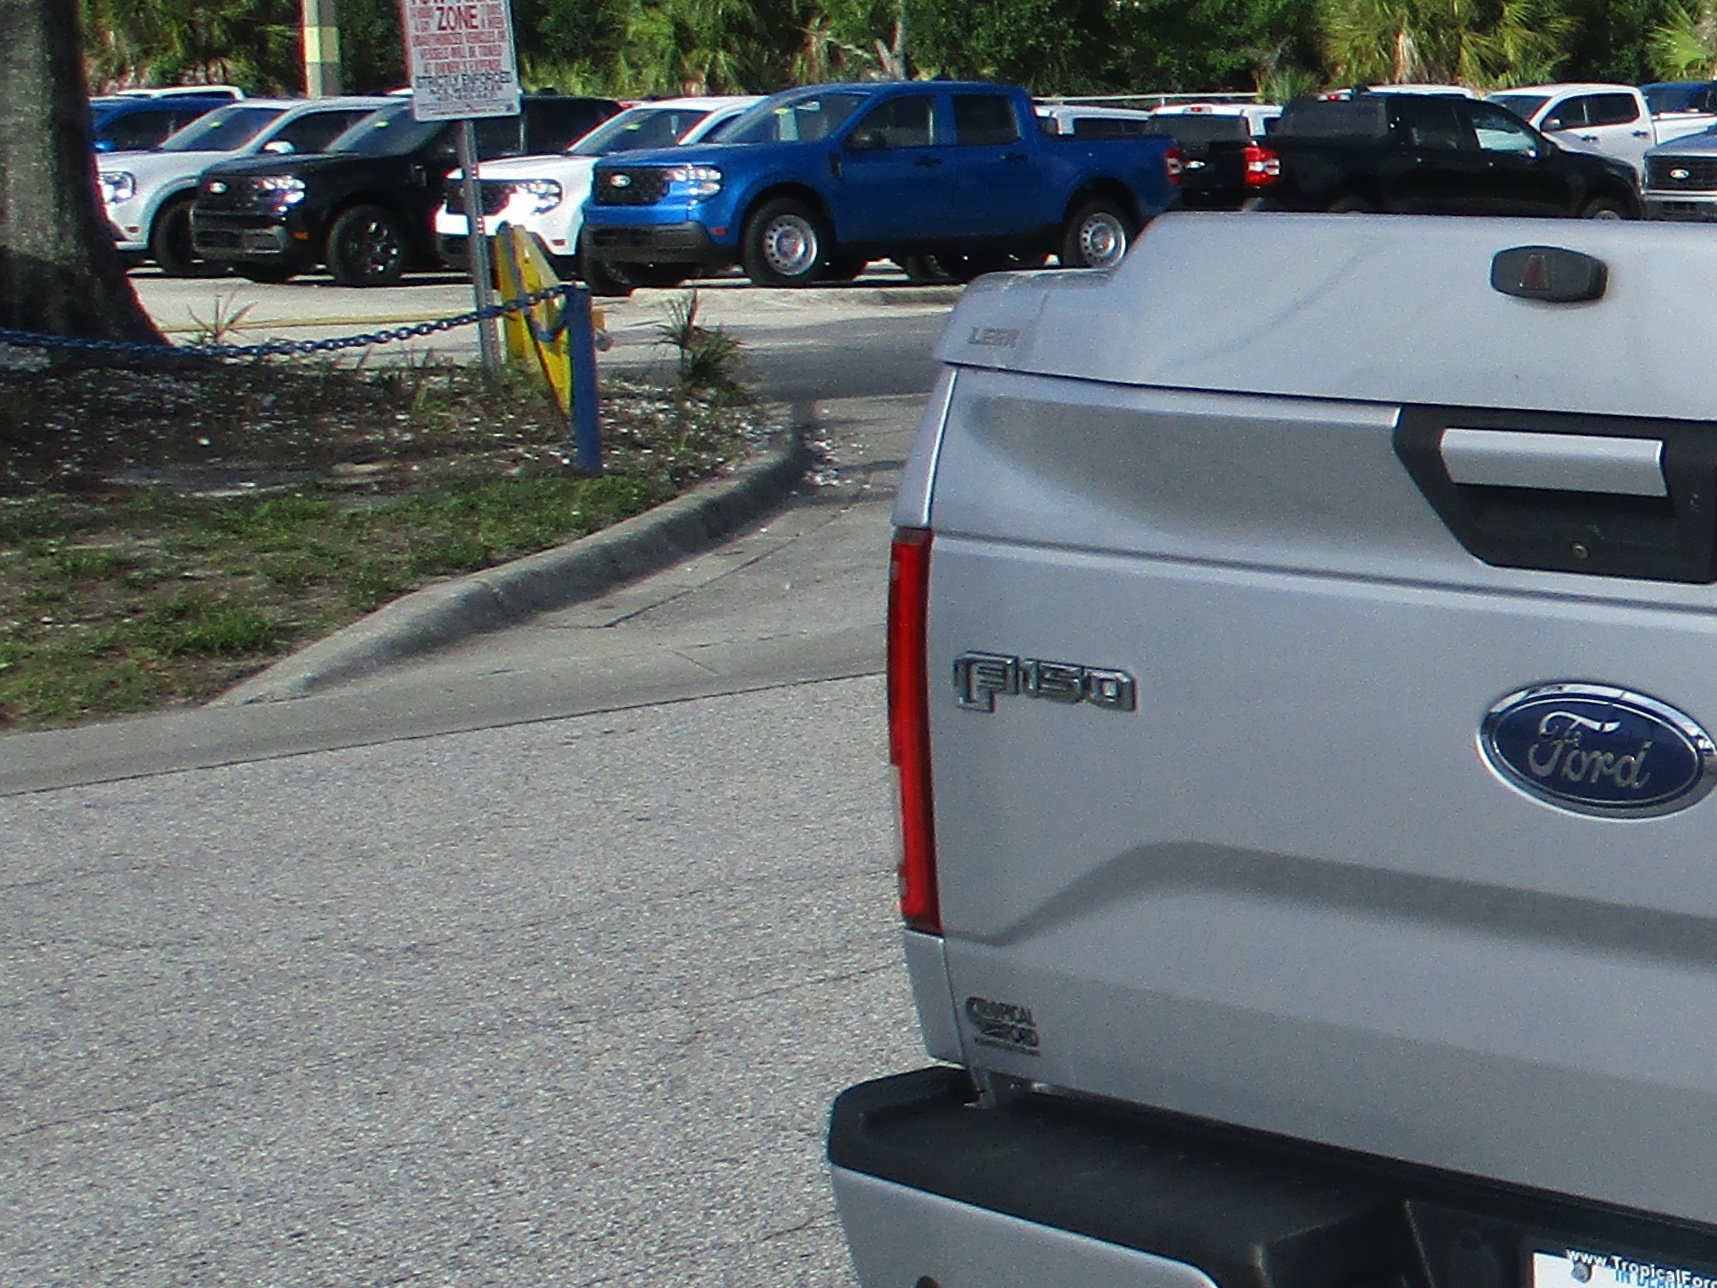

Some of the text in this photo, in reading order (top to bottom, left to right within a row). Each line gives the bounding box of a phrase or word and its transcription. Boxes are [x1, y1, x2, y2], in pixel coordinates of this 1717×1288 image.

[436, 4, 479, 31] ZONE
[461, 71, 513, 86] ENFORCED
[1527, 710, 1656, 791] Ford
